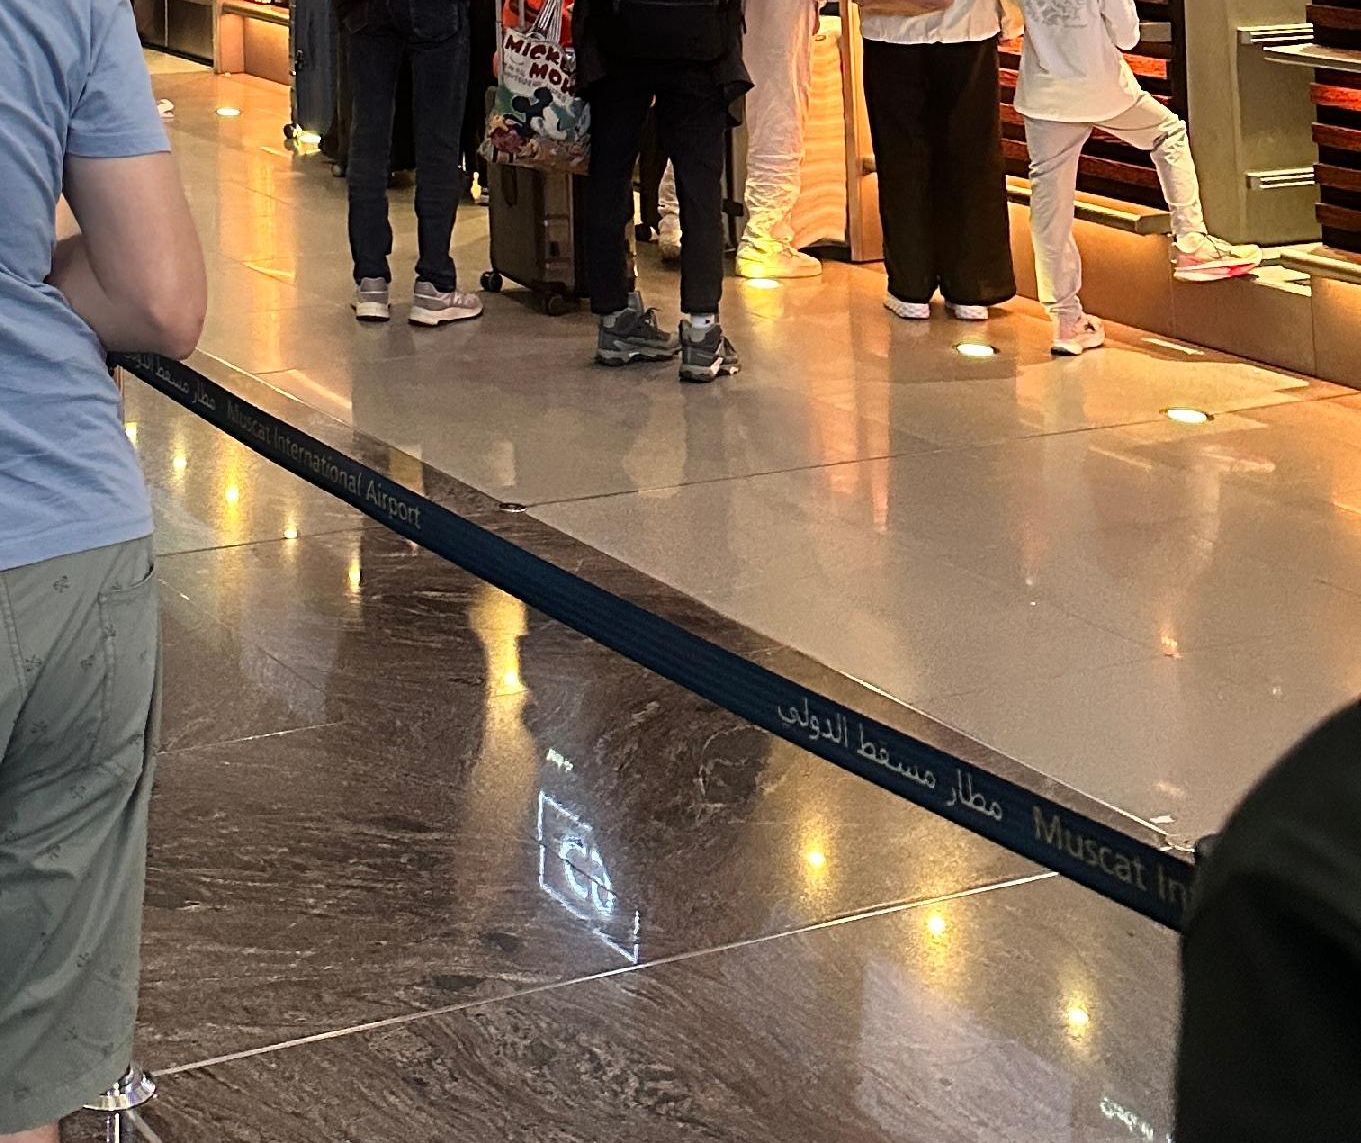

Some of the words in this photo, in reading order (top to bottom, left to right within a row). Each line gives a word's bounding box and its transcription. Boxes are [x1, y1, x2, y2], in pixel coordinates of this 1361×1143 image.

[226, 400, 271, 443] Muscat
[273, 426, 362, 497] International
[365, 479, 422, 530] Airport
[856, 723, 936, 789] مسقط
[944, 769, 1003, 822] مطار
[1032, 805, 1147, 891] Muscat
